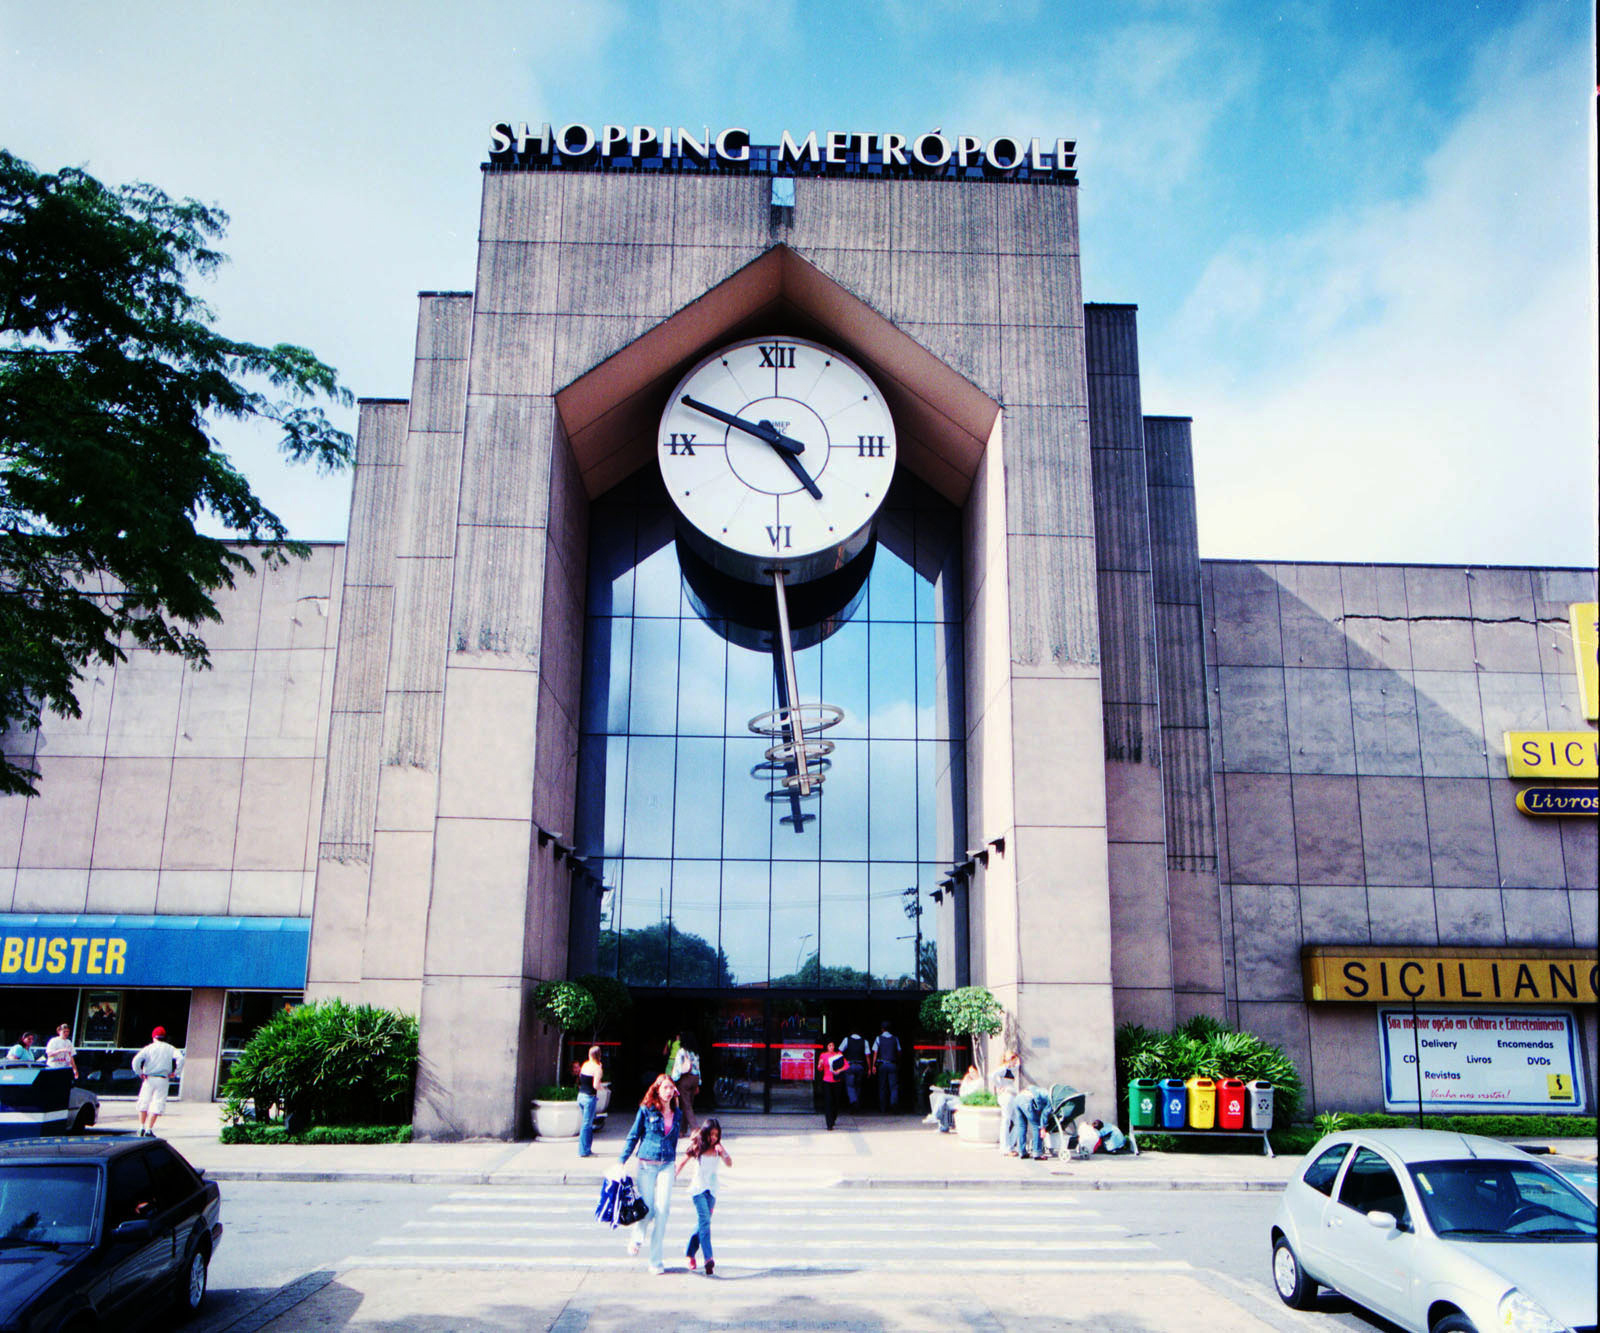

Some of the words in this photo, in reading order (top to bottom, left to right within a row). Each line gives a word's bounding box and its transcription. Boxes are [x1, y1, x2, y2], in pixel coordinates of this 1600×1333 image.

[488, 121, 750, 161] SHOPPING
[778, 128, 1078, 171] METRÓPOLE
[759, 346, 796, 368] XII
[669, 434, 697, 456] IX
[857, 435, 885, 457] III
[766, 526, 792, 548] VI
[1531, 794, 1598, 808] Livros
[0, 937, 127, 974] BUSTER
[1388, 1016, 1401, 1029] Sua
[1403, 1016, 1430, 1029] mehor
[1432, 1017, 1454, 1032] opção
[1455, 1019, 1468, 1030] em
[1469, 1016, 1497, 1030] Cultura
[1499, 1019, 1504, 1030] e
[1506, 1017, 1565, 1031] Entretenimento
[1421, 1039, 1458, 1050] Delivery
[1497, 1039, 1554, 1049] Encomendas
[1403, 1054, 1420, 1064] CD
[1466, 1055, 1492, 1064] Livros
[1527, 1056, 1551, 1066] DVDs
[1424, 1070, 1461, 1080] Revistas
